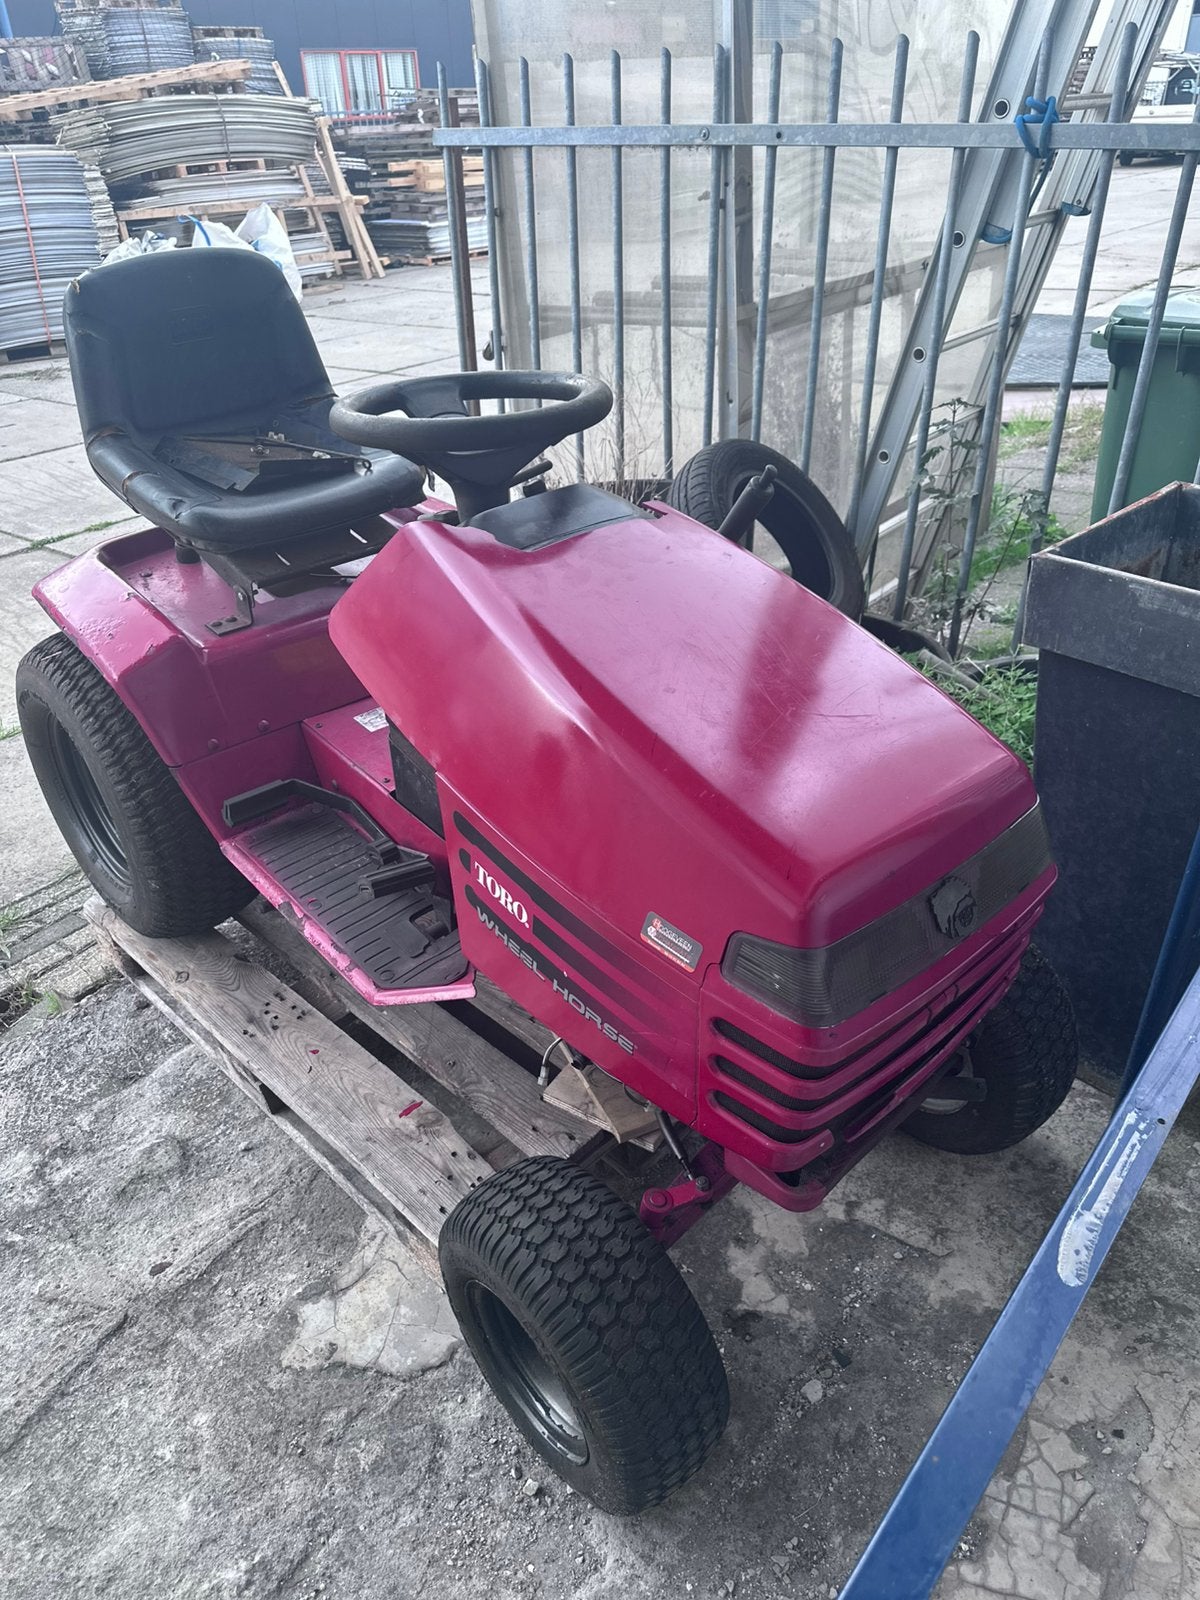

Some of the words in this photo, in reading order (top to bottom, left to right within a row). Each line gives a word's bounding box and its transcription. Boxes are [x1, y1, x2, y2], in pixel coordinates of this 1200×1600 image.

[474, 861, 528, 924] TORO
[476, 906, 546, 982] WHEEL
[552, 979, 635, 1055] HORSE
